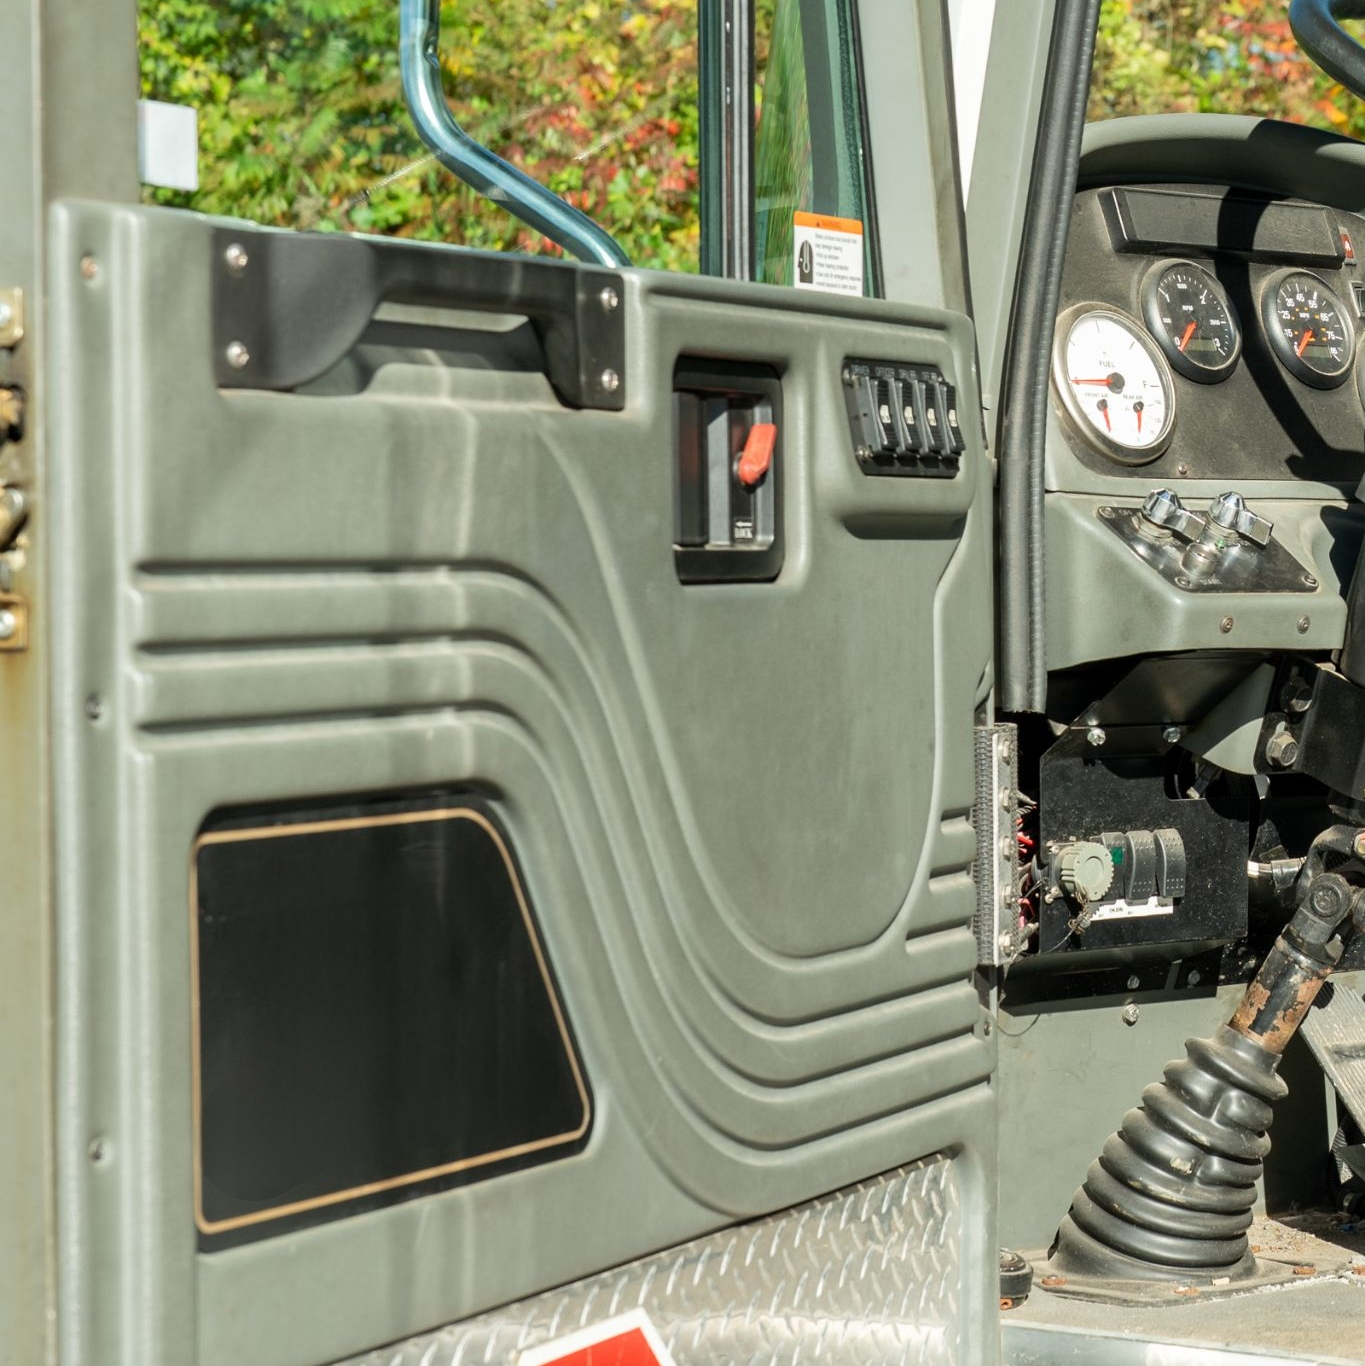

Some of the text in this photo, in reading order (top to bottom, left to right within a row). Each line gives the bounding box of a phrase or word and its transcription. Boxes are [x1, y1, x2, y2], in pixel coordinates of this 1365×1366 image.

[1286, 297, 1295, 307] 35
[1296, 293, 1305, 302] 45
[1308, 299, 1318, 309] 55
[1282, 310, 1291, 320] 25
[1326, 331, 1336, 340] 75
[1099, 360, 1115, 368] FUEL
[1142, 380, 1148, 389] F
